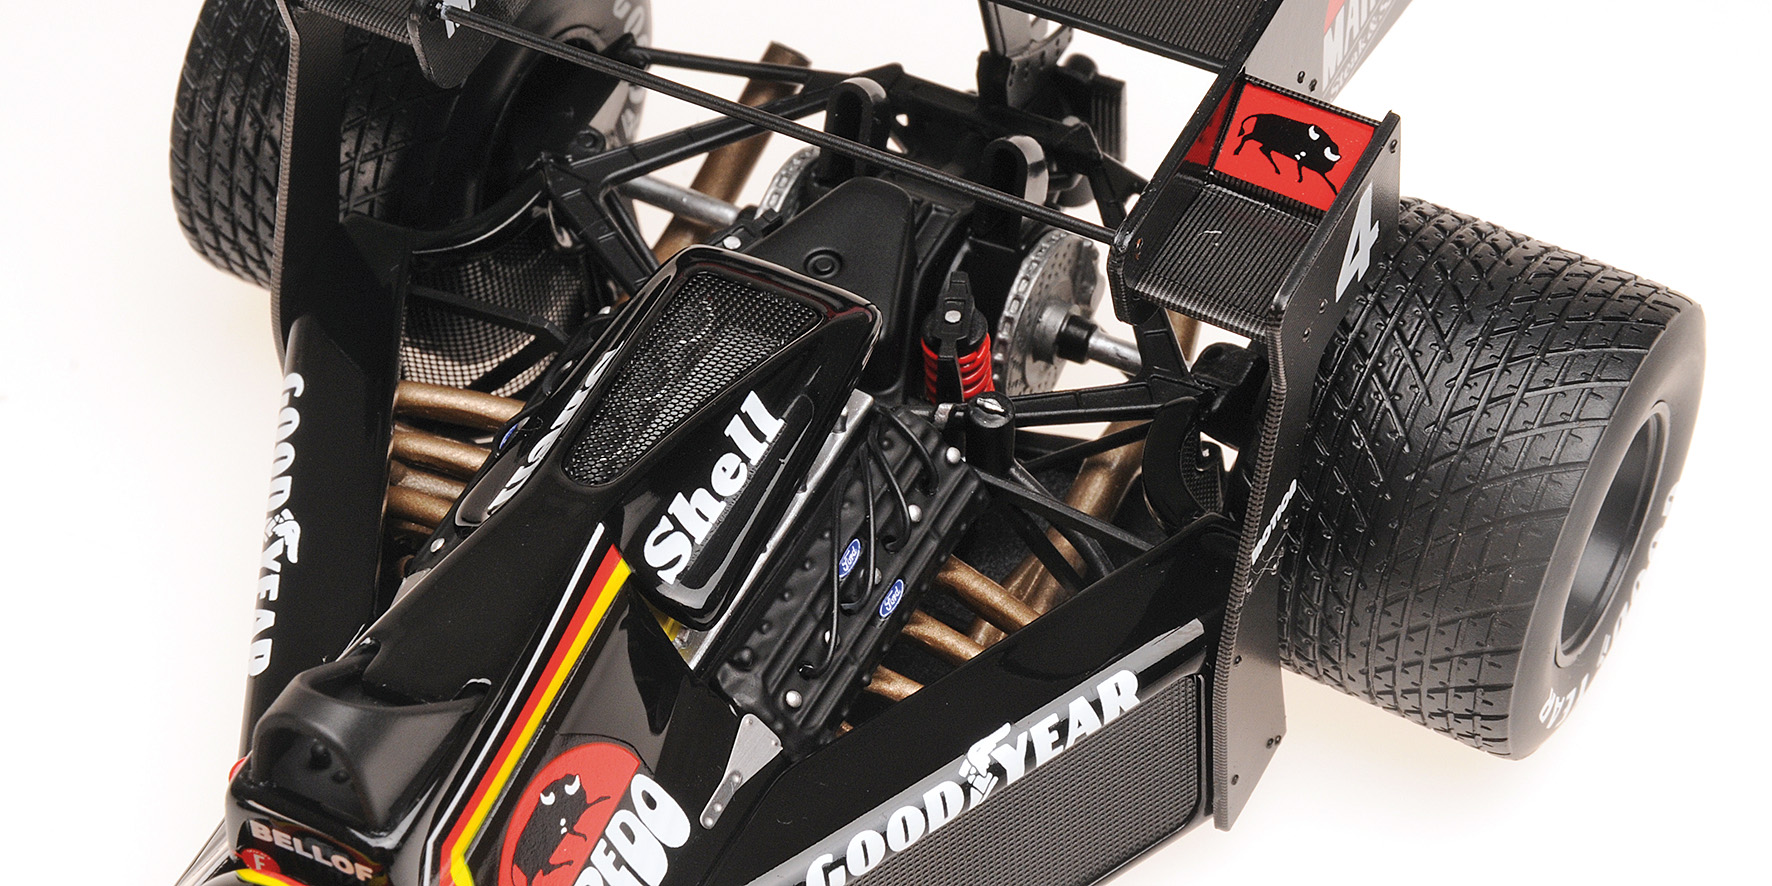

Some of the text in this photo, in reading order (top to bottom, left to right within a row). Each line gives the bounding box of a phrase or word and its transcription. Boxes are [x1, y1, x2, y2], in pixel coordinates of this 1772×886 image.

[1335, 181, 1380, 304] 4
[643, 390, 786, 585] Shell
[882, 584, 901, 612] Ford
[574, 773, 691, 886] EDO
[805, 669, 1141, 886] GOODYEAR
[250, 820, 373, 882] BELLOF
